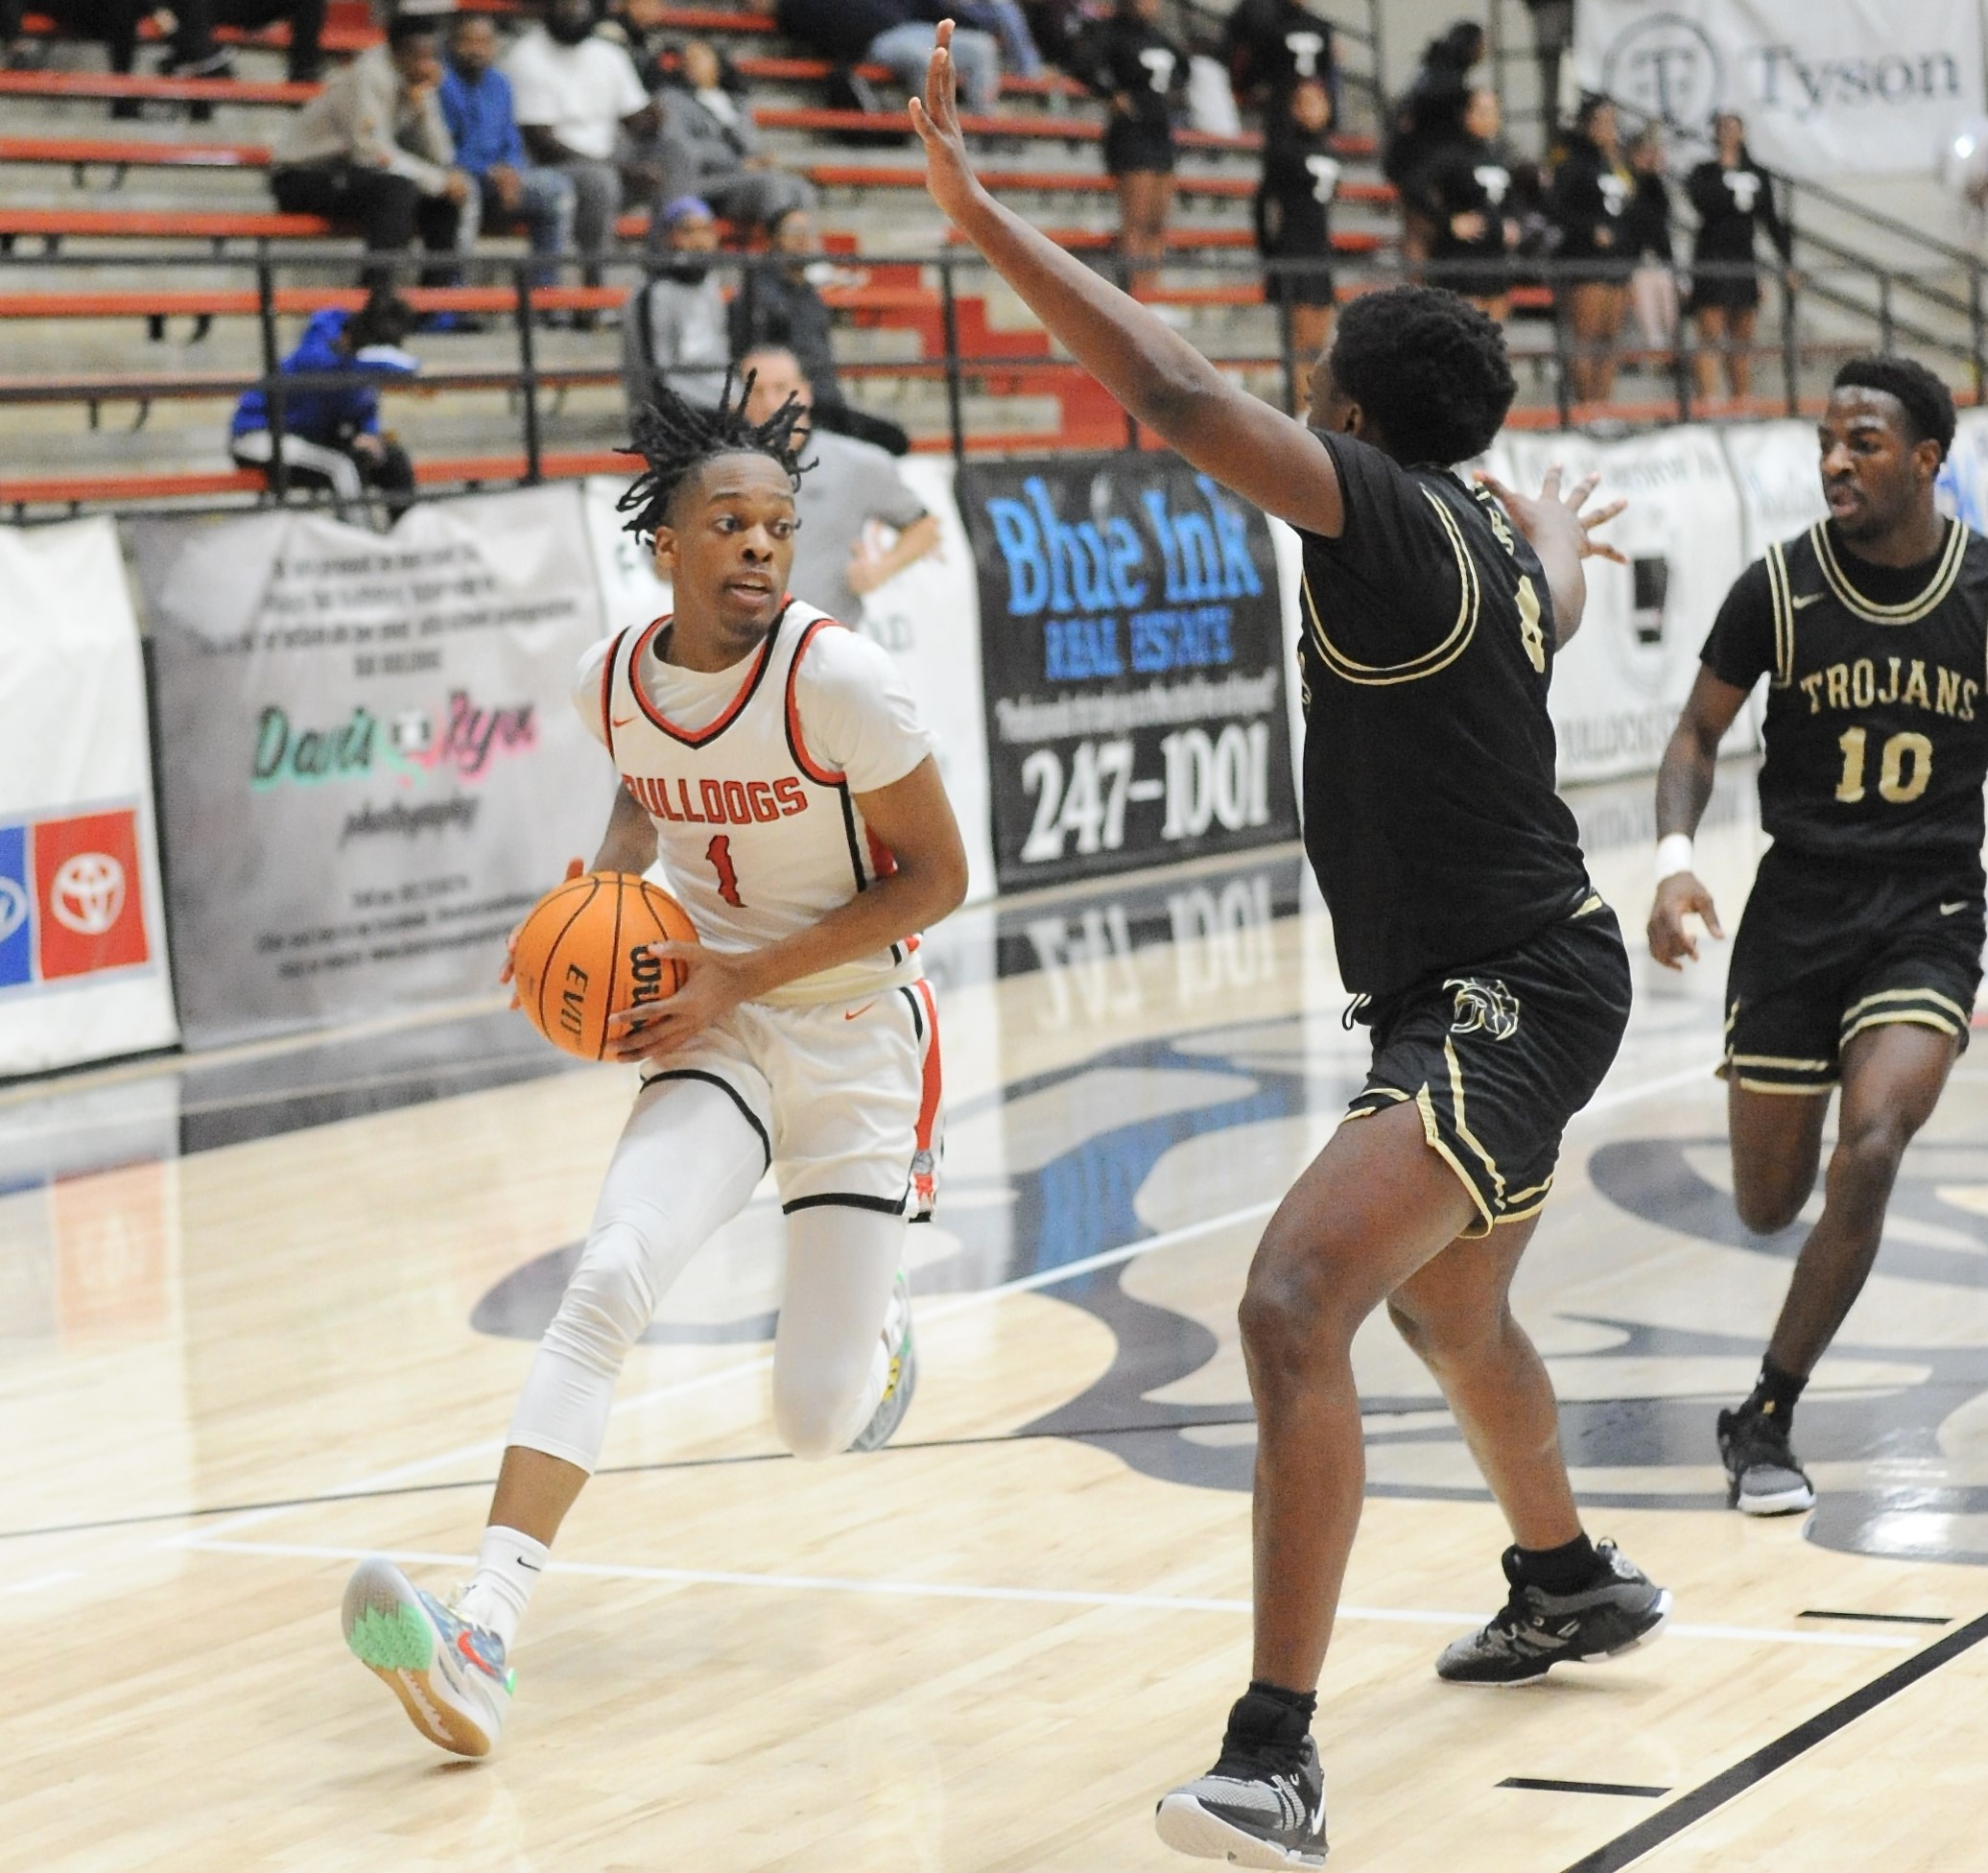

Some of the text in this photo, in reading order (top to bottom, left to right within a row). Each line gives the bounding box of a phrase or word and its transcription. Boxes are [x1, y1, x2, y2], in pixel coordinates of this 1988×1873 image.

[1746, 44, 1959, 121] Tyson
[985, 475, 1263, 616] Blue Ink
[1800, 656, 1978, 722] TROJANS
[1021, 721, 1271, 863] 247-1001
[1835, 725, 1933, 803] 10
[705, 834, 748, 909] 1
